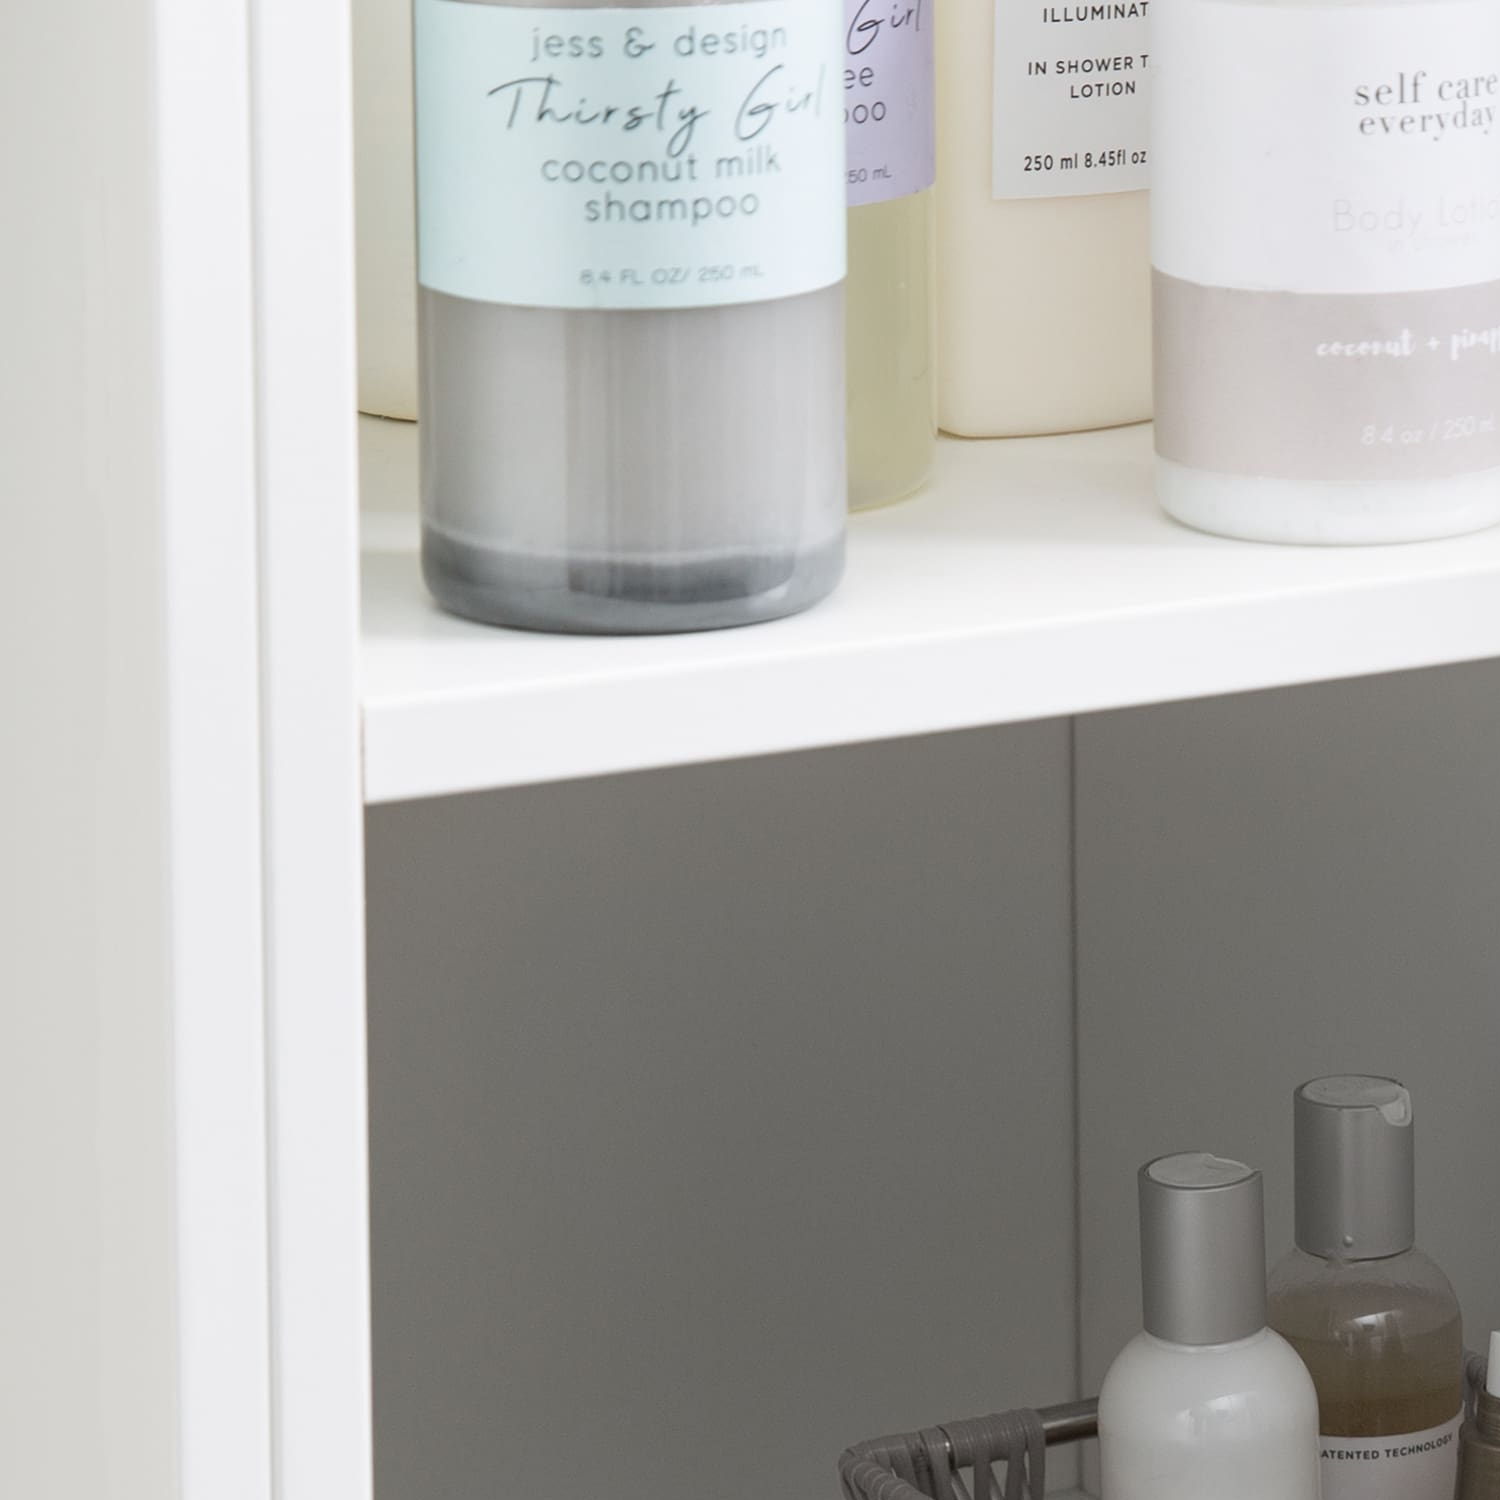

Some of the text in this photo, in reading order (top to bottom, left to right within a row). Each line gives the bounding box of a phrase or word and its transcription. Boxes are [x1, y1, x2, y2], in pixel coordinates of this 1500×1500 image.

[847, 0, 922, 55] Girl
[1043, 2, 1149, 23] ILLUMINAT
[530, 25, 787, 61] jess & design
[1028, 61, 1047, 75] IN
[1056, 56, 1133, 74] SHOWER
[1070, 81, 1136, 99] LOTION
[1354, 70, 1498, 106] self care
[488, 62, 826, 158] Thirsty Girl
[844, 101, 886, 124] oo
[1359, 100, 1497, 141] everyday
[540, 144, 783, 184] coconut milk
[845, 168, 868, 184] 50
[1024, 155, 1053, 171] 250
[1060, 153, 1078, 169] ml
[1131, 150, 1147, 164] oz
[584, 189, 760, 227] shampoo
[1385, 1432, 1453, 1458] TECHNOLOGY
